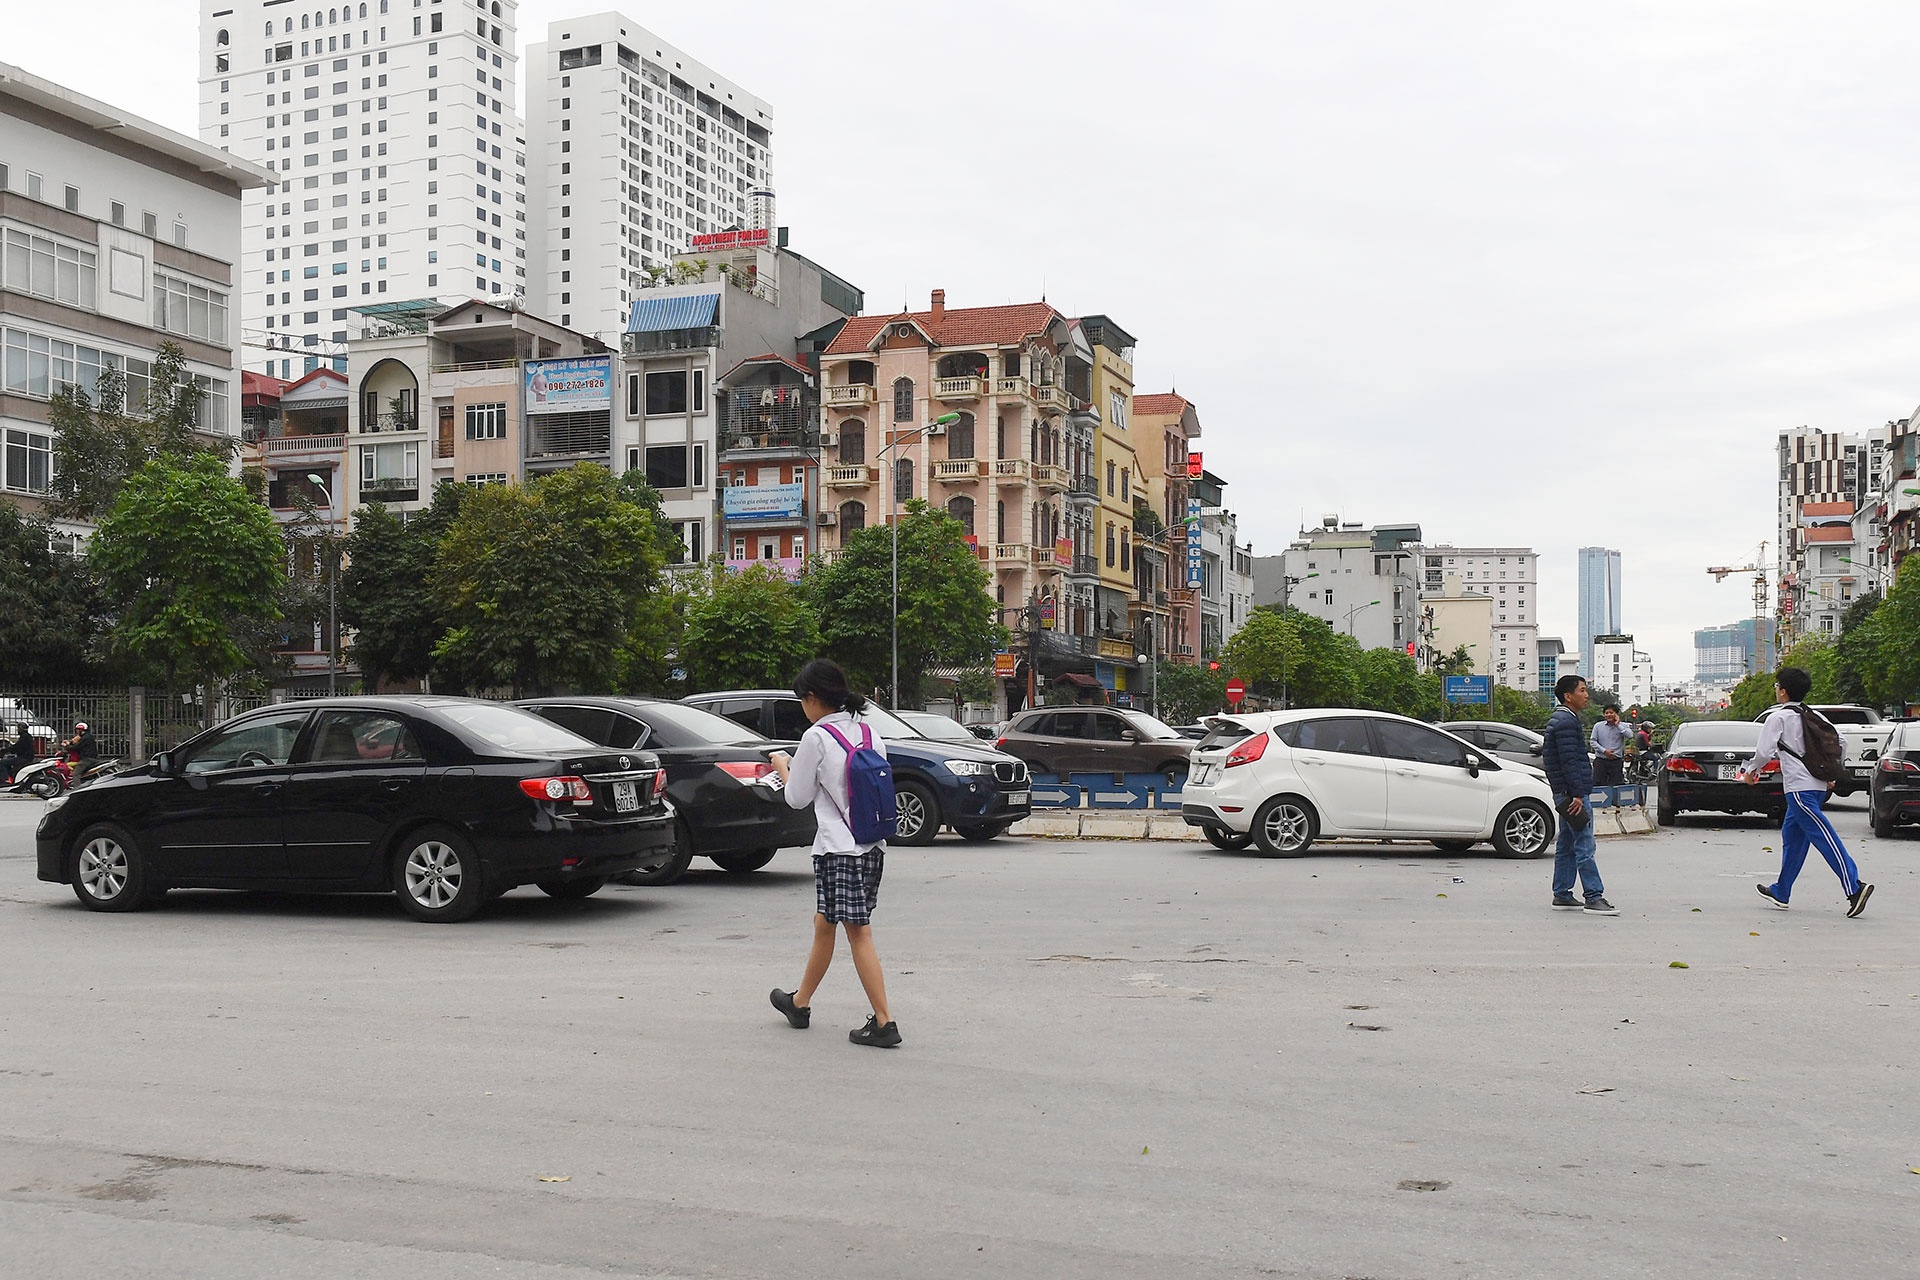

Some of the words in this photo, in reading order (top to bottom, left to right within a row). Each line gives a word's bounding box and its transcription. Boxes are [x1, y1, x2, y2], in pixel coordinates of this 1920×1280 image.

[693, 232, 736, 246] APARTMENT
[738, 231, 752, 241] FOR
[618, 783, 632, 796] 29A
